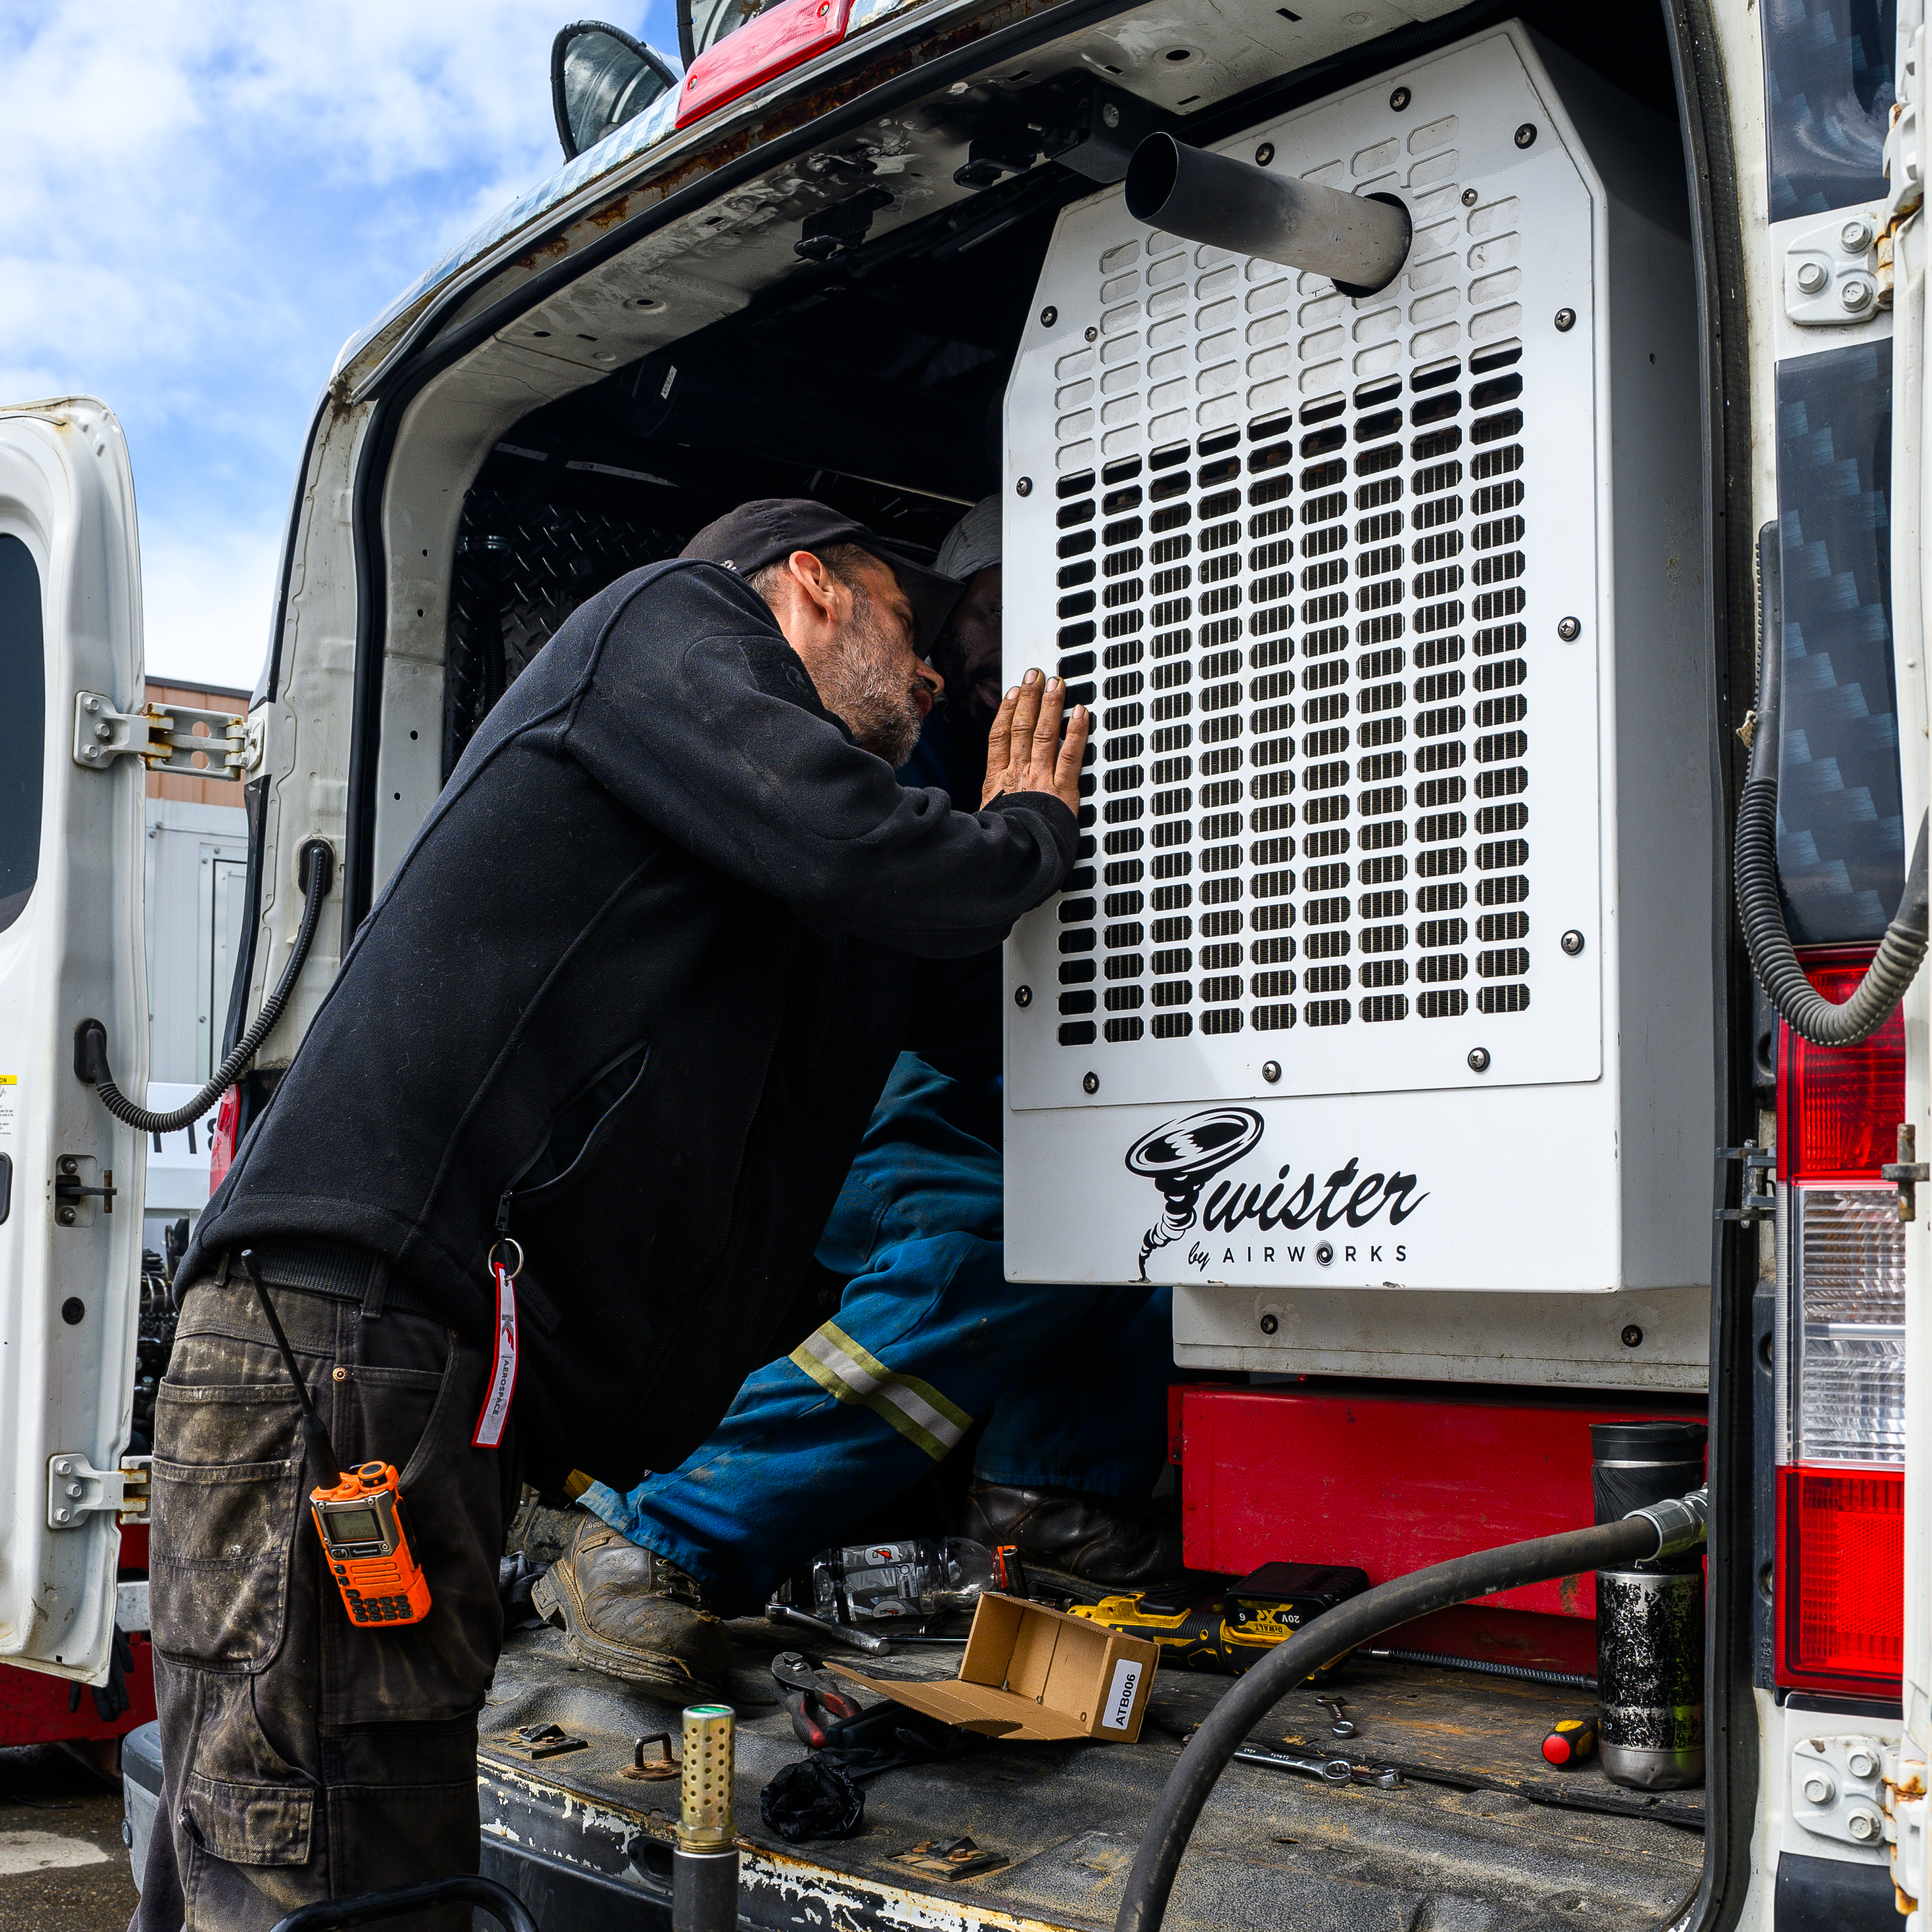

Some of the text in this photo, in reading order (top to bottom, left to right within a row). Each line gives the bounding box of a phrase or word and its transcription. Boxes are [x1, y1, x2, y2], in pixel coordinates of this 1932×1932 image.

[1188, 1241, 1407, 1272] by AIRWORKS
[492, 1360, 509, 1415] AEROSPACE
[1239, 1613, 1246, 1621] 6
[1256, 1610, 1278, 1624] XR
[1282, 1614, 1300, 1623] 20V
[1116, 1674, 1136, 1726] ATB006
